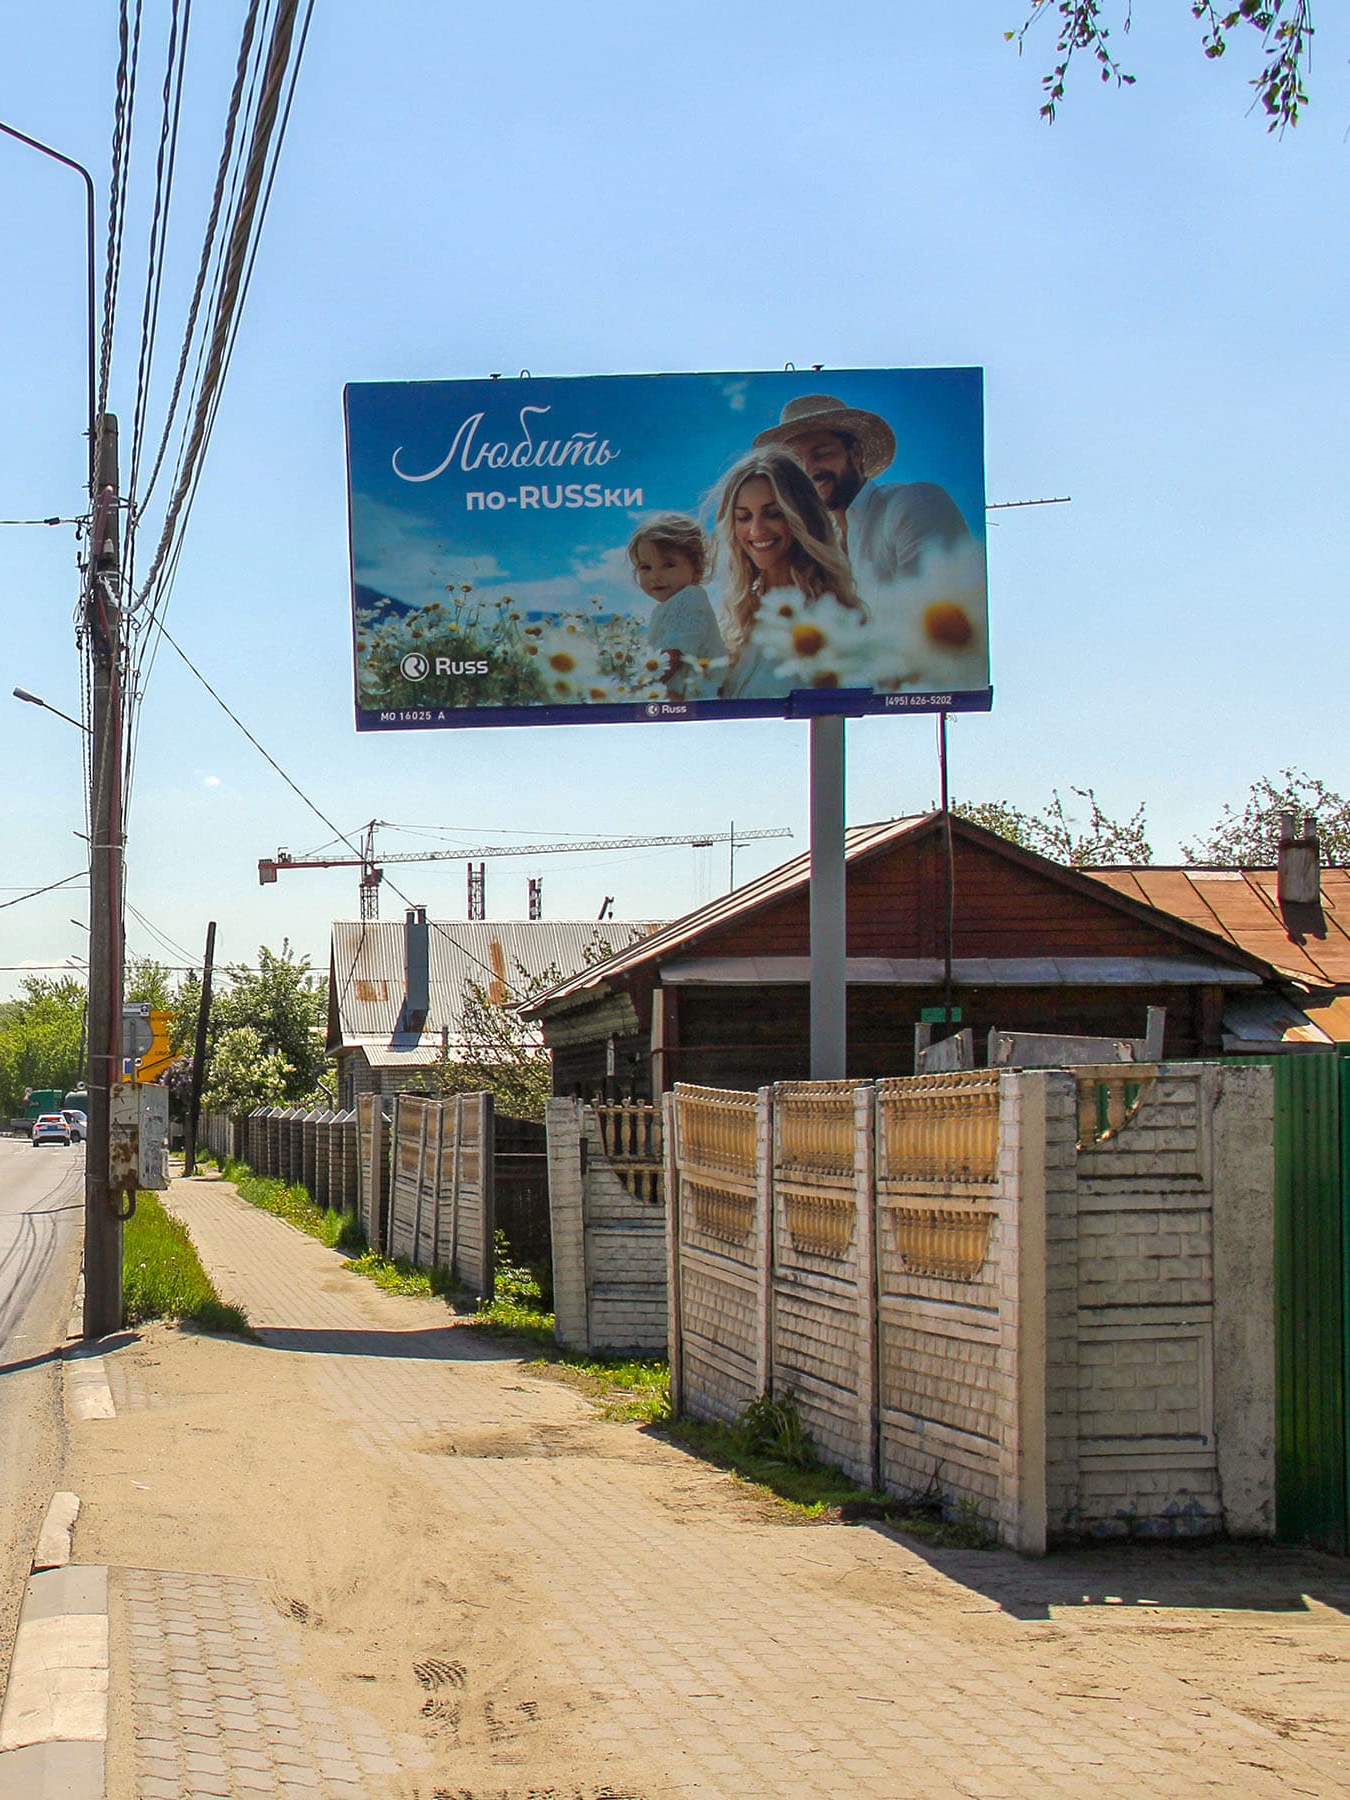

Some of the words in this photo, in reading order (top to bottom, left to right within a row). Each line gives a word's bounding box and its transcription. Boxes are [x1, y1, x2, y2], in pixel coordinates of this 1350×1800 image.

[392, 405, 621, 482] Любить
[466, 484, 644, 510] по-RUSSки
[435, 657, 488, 675] Russ
[910, 695, 952, 705] 626-5202
[399, 711, 432, 720] 16025
[661, 704, 687, 714] Russ
